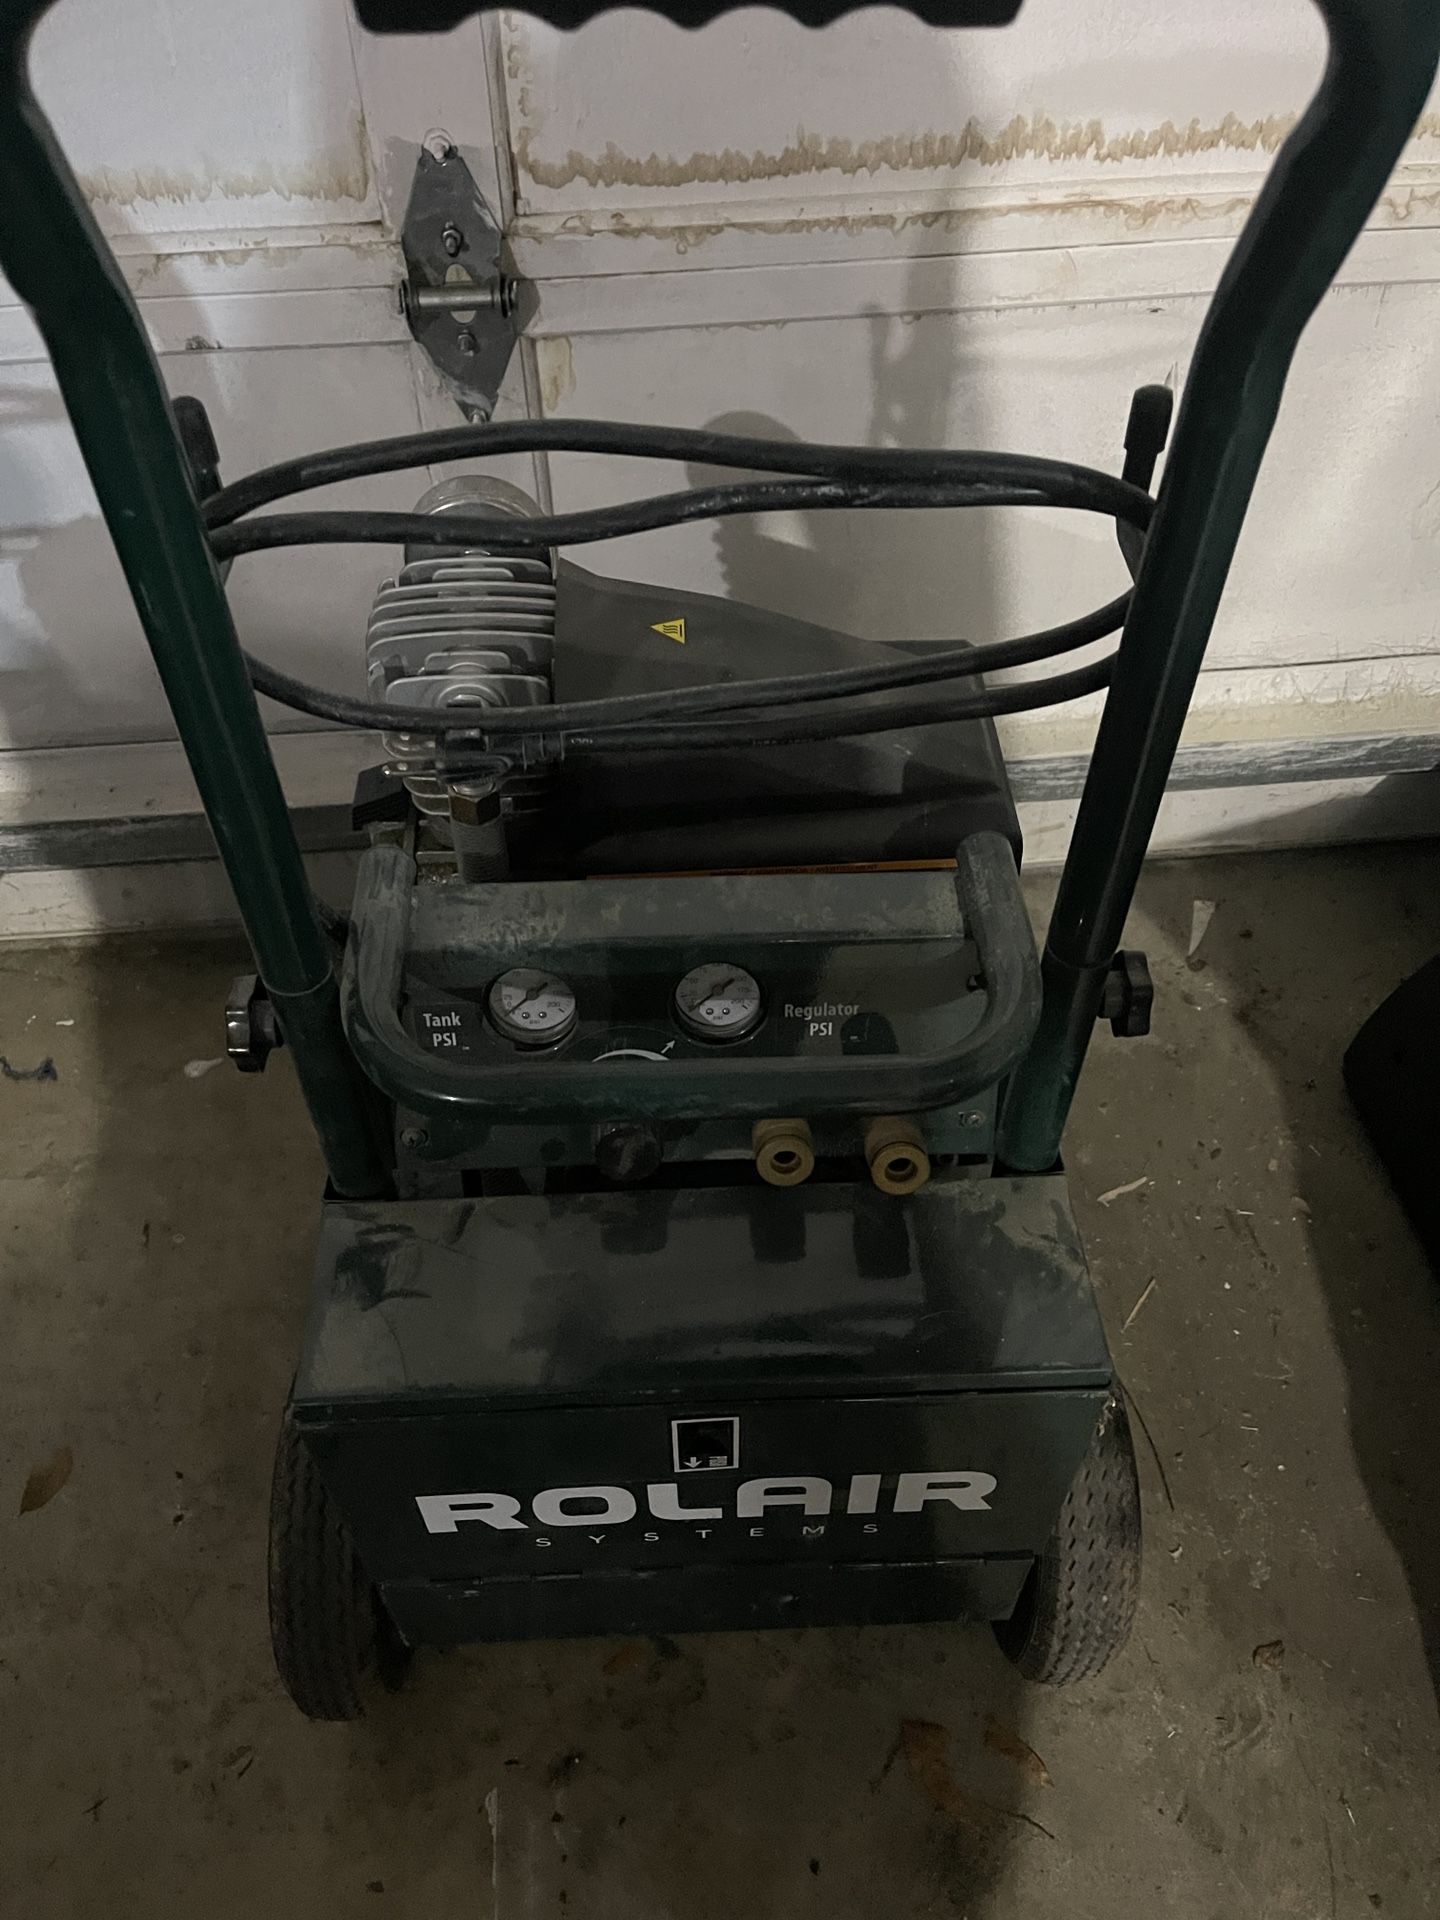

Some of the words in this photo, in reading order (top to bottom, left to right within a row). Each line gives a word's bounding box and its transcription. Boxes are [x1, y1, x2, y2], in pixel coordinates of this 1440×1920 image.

[422, 1011, 461, 1027] Tank
[784, 1002, 860, 1021] Regulator
[809, 1022, 833, 1037] PSI
[432, 1032, 457, 1047] PSI
[414, 1471, 998, 1534] ROLAIR
[534, 1523, 878, 1548] SYSTEMS
